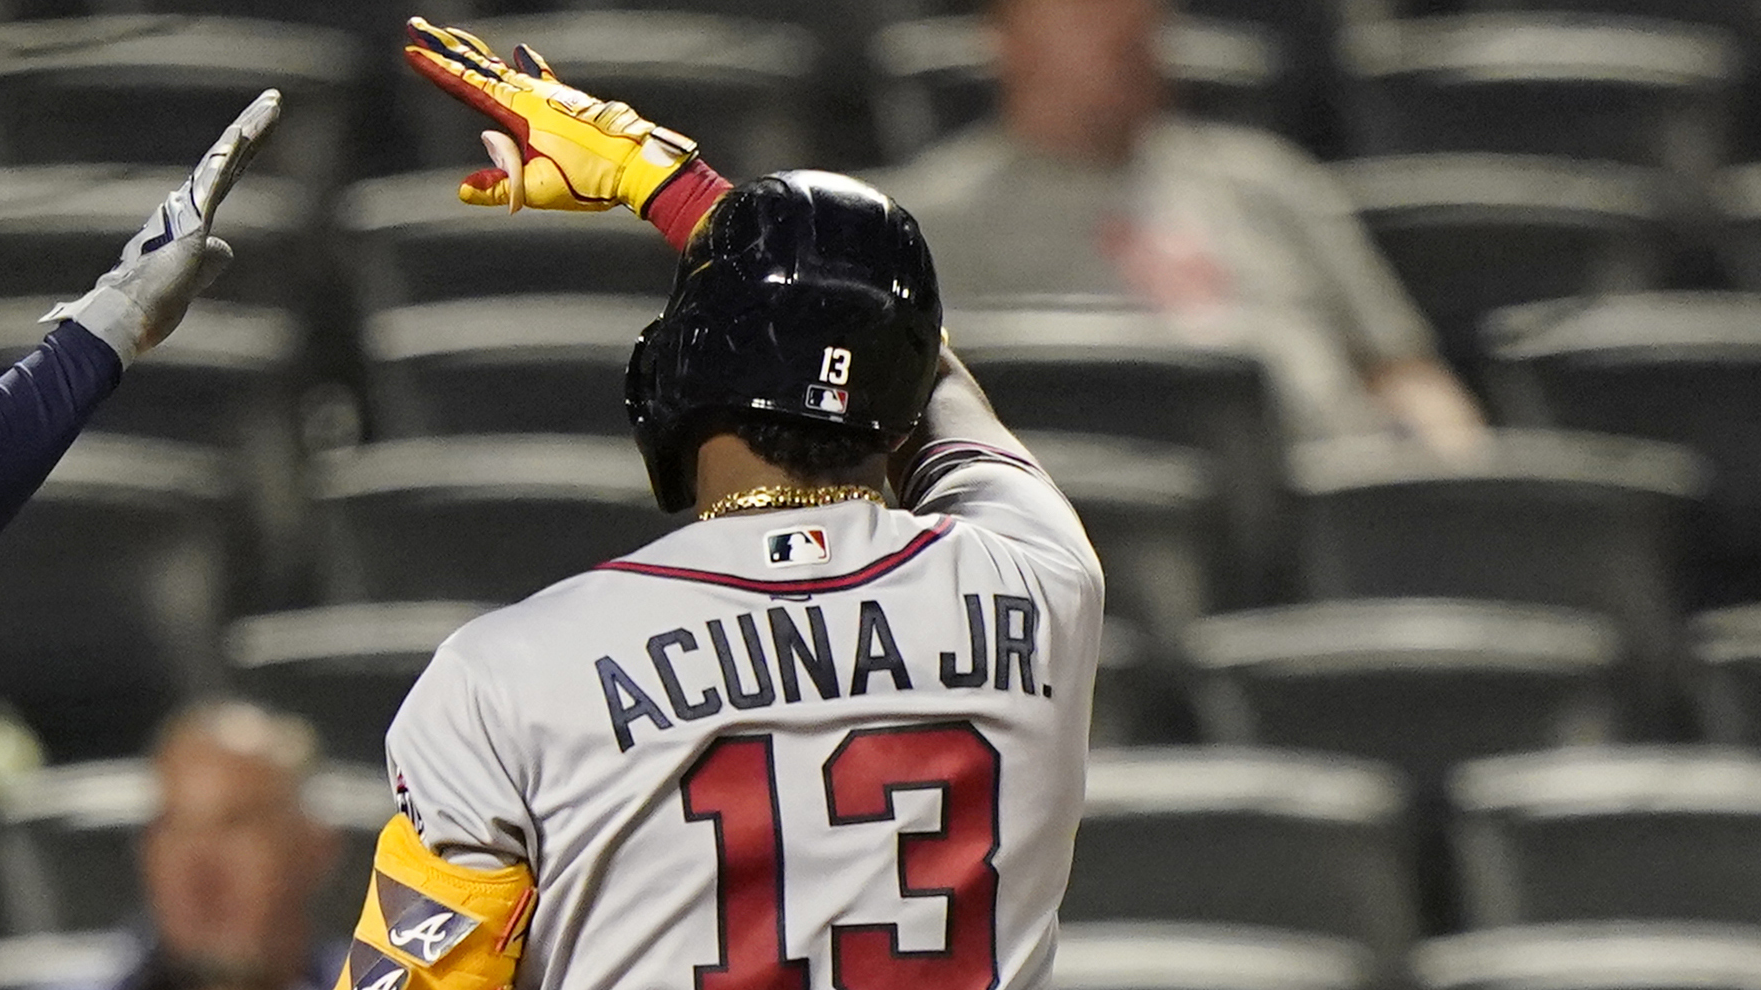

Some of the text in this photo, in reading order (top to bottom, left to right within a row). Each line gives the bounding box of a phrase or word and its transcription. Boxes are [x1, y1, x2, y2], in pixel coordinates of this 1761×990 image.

[819, 346, 852, 386] 13
[594, 593, 1053, 753] ACUÑA JR.
[390, 912, 455, 962] A
